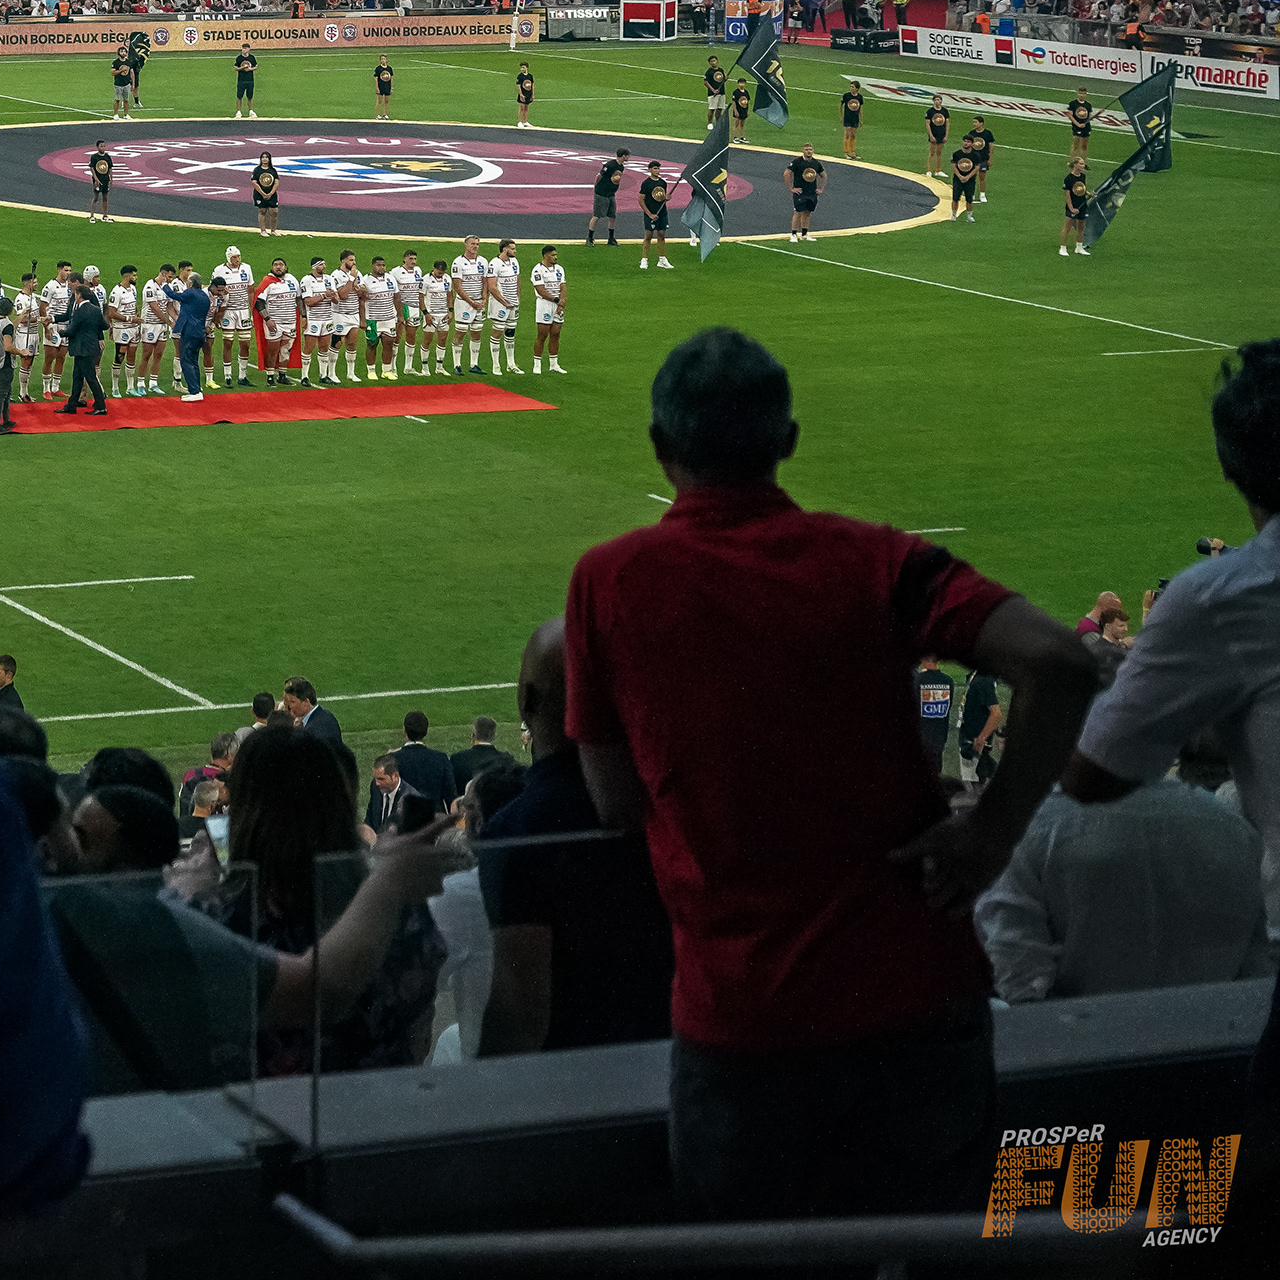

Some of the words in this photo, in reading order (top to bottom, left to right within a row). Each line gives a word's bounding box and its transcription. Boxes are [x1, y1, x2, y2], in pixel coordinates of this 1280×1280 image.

[565, 8, 609, 20] TISSOT
[30, 33, 99, 44] BORDEAUX
[101, 29, 131, 43] BÈGL
[203, 30, 242, 41] STADE
[244, 28, 320, 40] TOULOUSAIN
[363, 27, 401, 38] UNION
[402, 25, 468, 37] BORDEAUX
[470, 22, 512, 35] BÈGLES
[928, 32, 972, 47] SOCIETE
[929, 45, 983, 61] GENERALE
[1048, 50, 1137, 77] TotalEnergies
[1150, 55, 1269, 89] Inermarché
[923, 703, 947, 715] GMF
